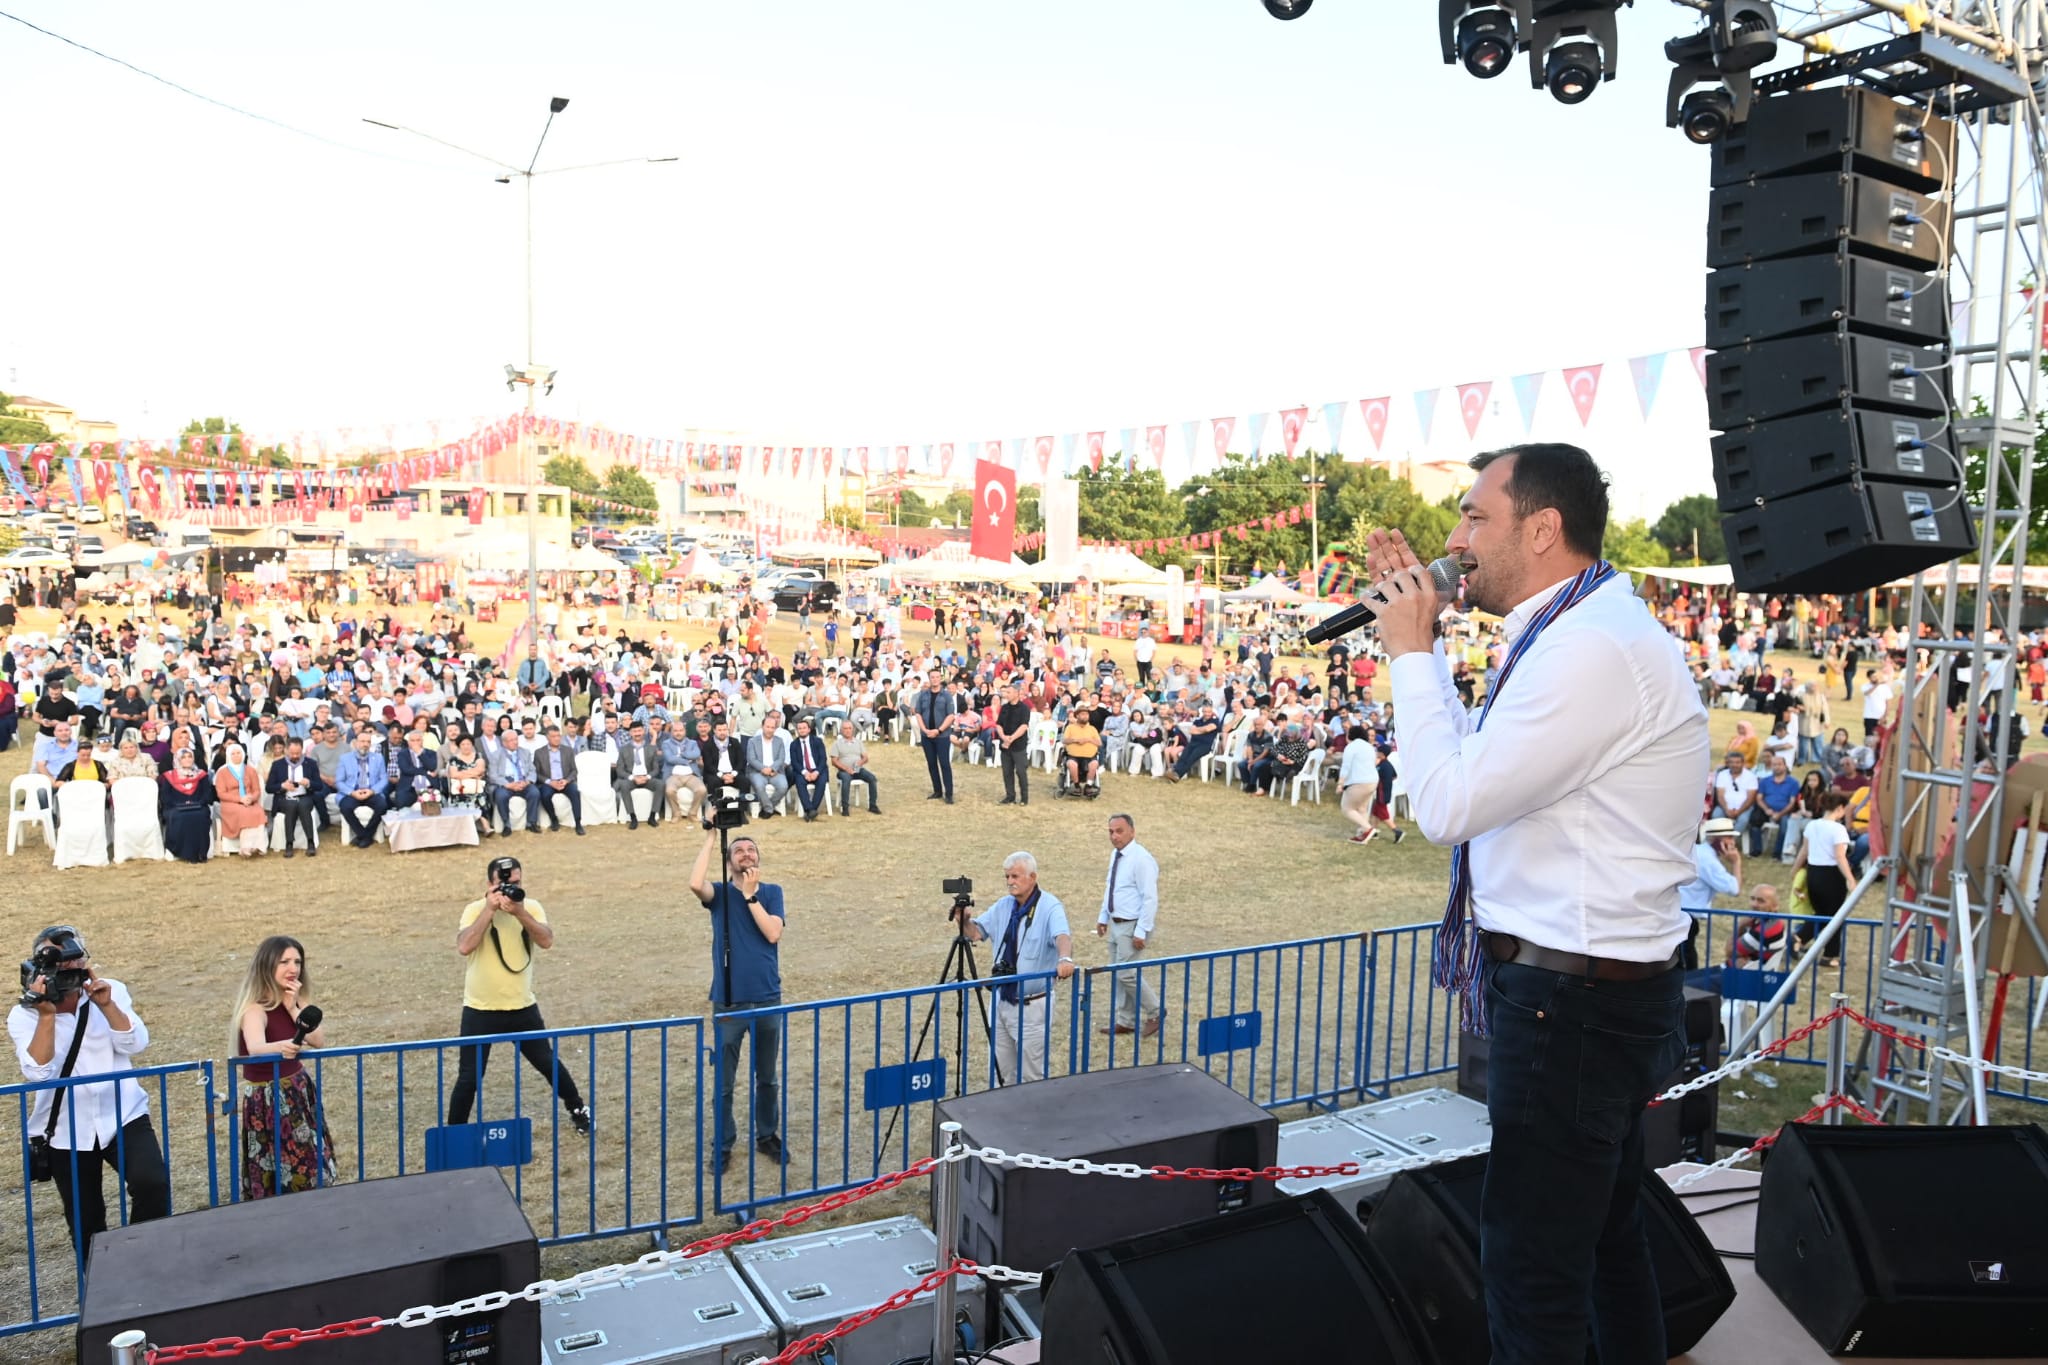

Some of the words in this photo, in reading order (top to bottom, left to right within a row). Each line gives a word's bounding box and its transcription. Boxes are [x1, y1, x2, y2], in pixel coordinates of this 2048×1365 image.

[1234, 1018, 1246, 1028] 59
[911, 1073, 931, 1090] 59
[488, 1127, 507, 1140] 59
